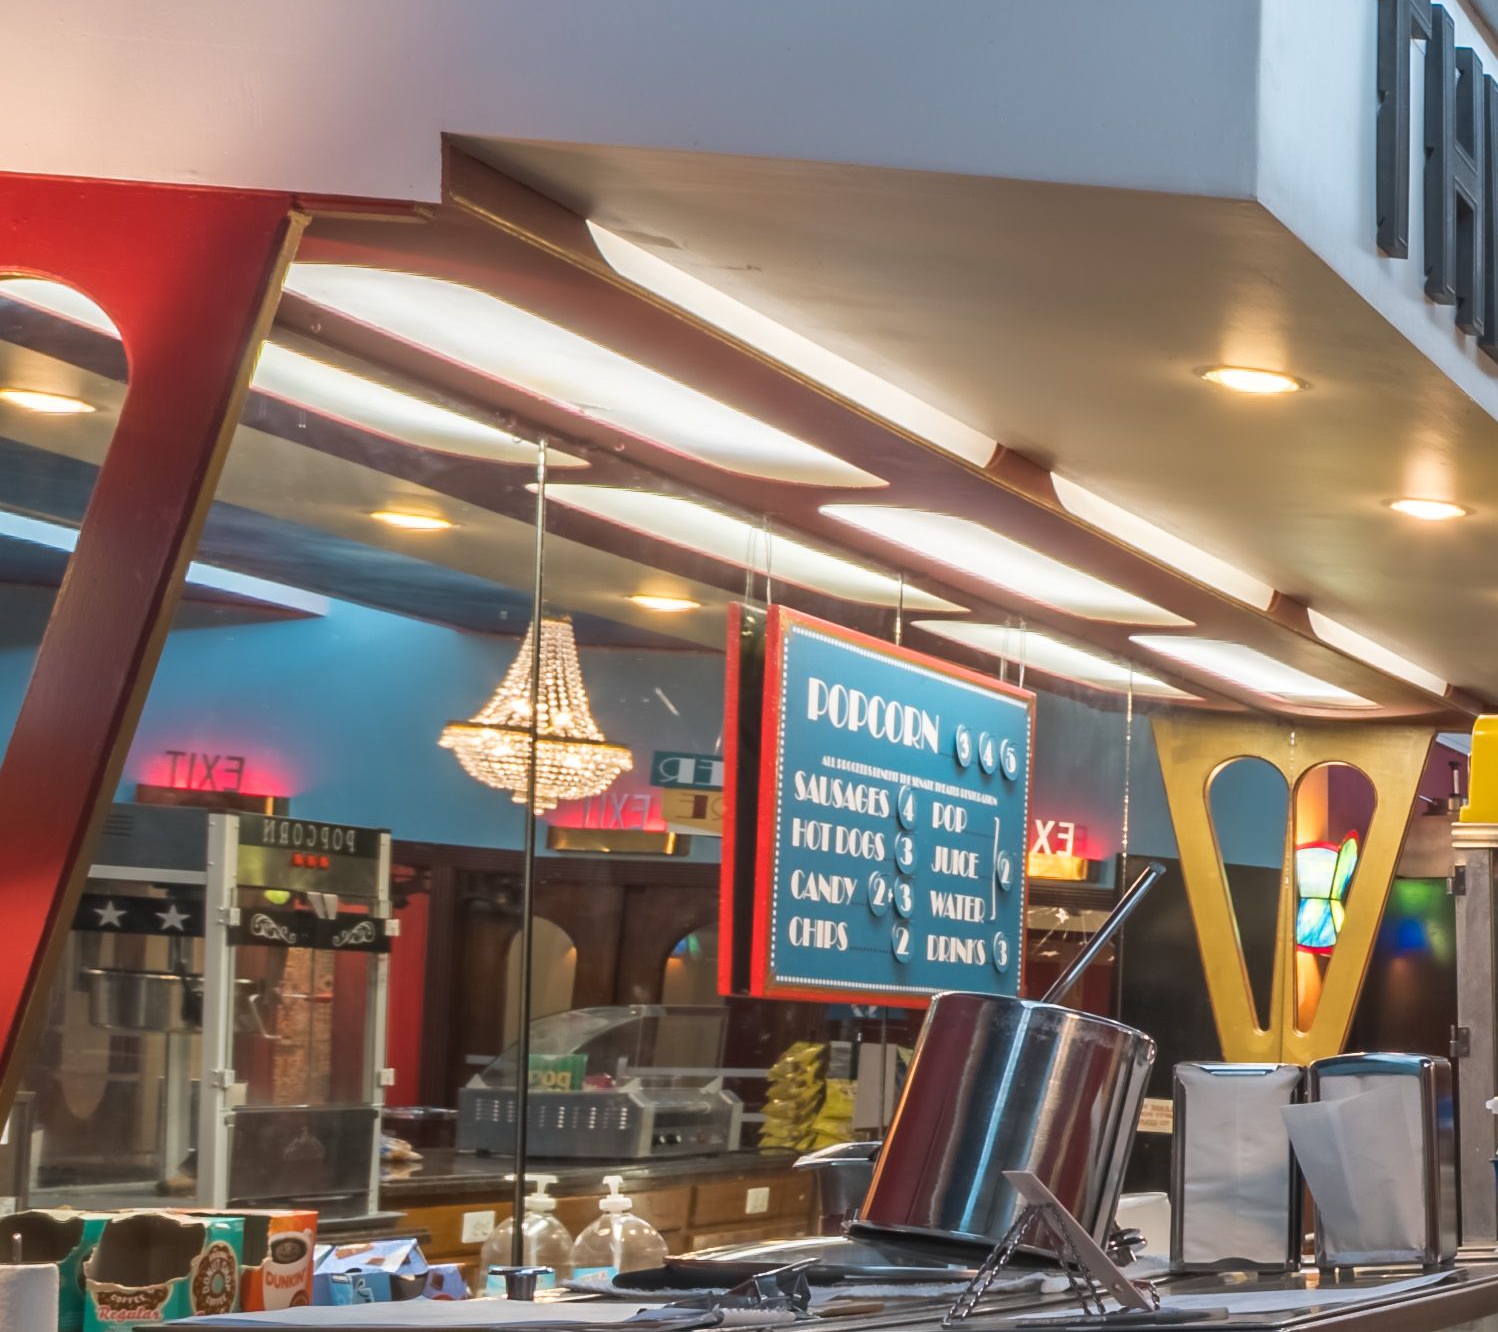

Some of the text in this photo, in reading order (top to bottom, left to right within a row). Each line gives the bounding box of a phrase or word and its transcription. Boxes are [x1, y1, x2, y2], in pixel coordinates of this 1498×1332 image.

[807, 677, 1017, 774] POPCORN 3 4 5
[794, 770, 914, 821] SAUSAGES 4
[932, 801, 968, 833] POP
[792, 818, 913, 866] HOT DOGS 3
[931, 846, 1011, 884] JUICE 2
[790, 869, 858, 906] CANDY
[872, 877, 886, 907] 2
[900, 883, 912, 912] 3
[930, 890, 986, 924] WATER
[789, 916, 910, 955] CHIPS 2
[927, 934, 1008, 967] DRINKS 3
[97, 1305, 162, 1322] Regular
[109, 1293, 147, 1303] COFFEE
[205, 1293, 227, 1307] COFFEE
